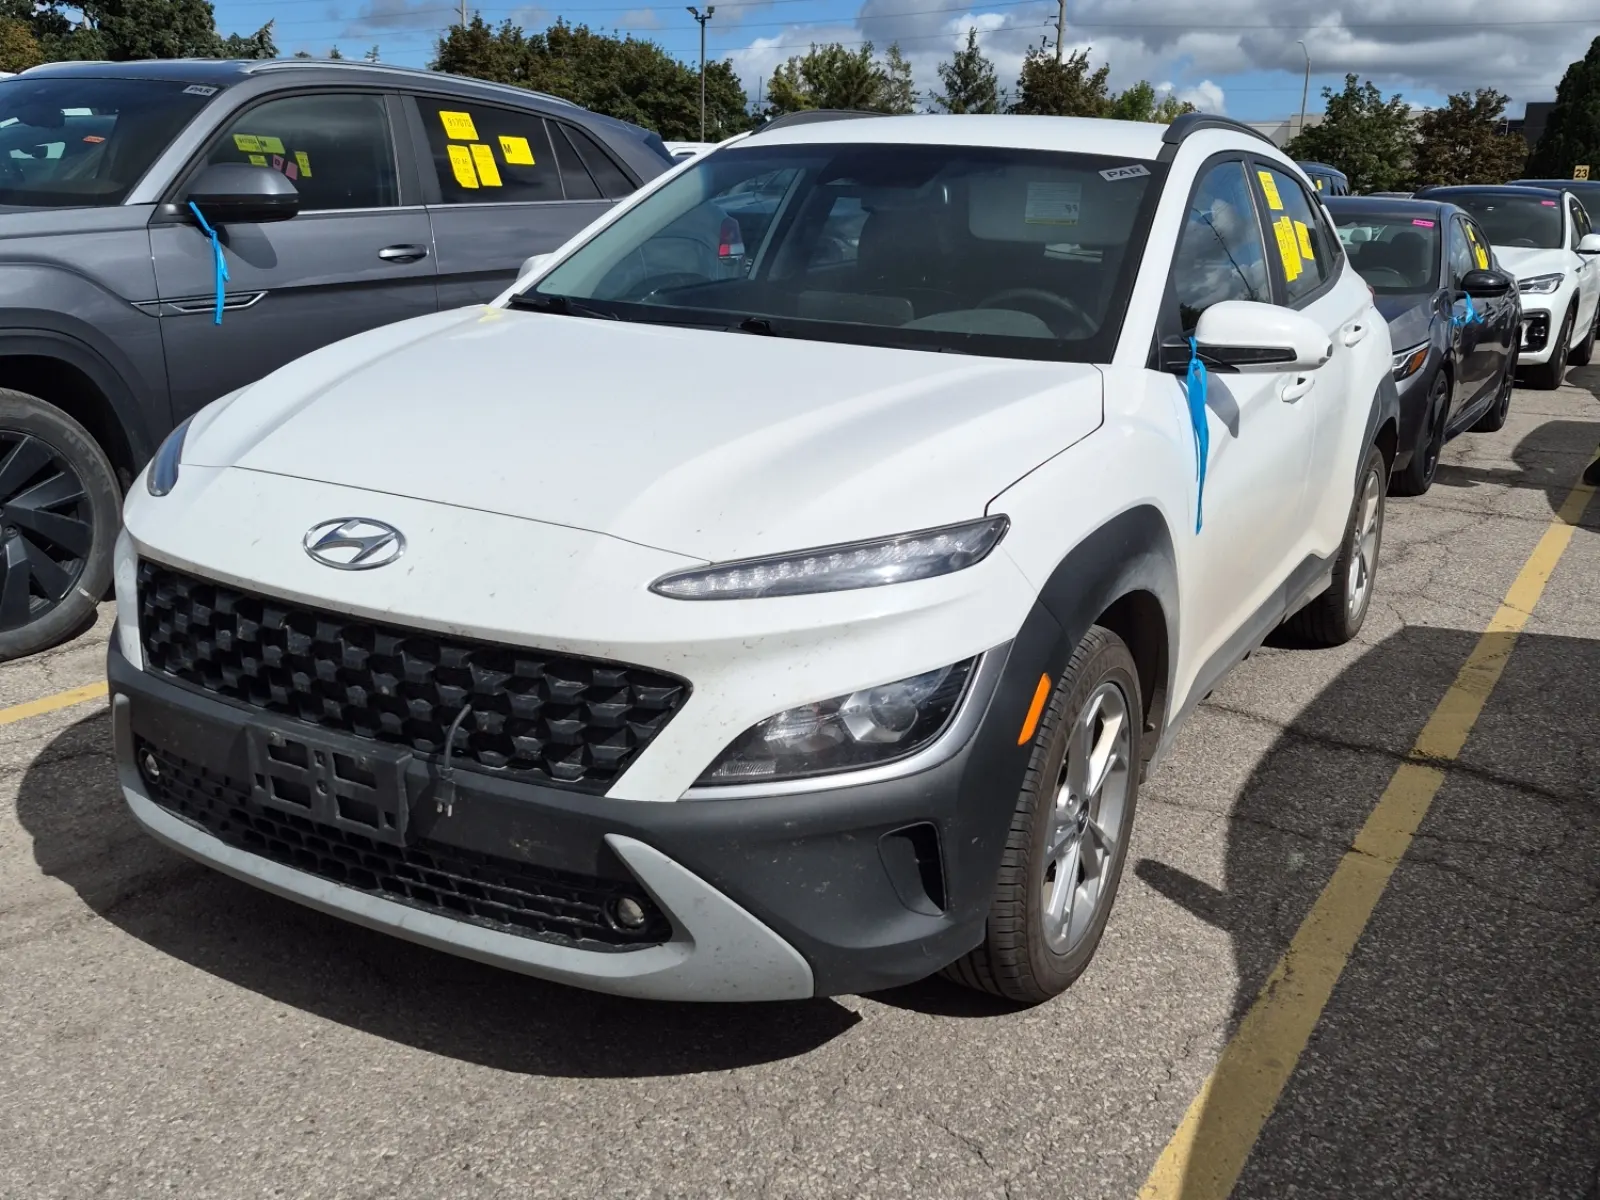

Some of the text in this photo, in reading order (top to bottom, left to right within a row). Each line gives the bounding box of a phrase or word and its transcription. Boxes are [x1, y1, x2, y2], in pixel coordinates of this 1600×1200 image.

[189, 85, 212, 94] PAR
[502, 143, 513, 155] M
[1106, 167, 1143, 178] PAR
[1575, 168, 1587, 178] 23
